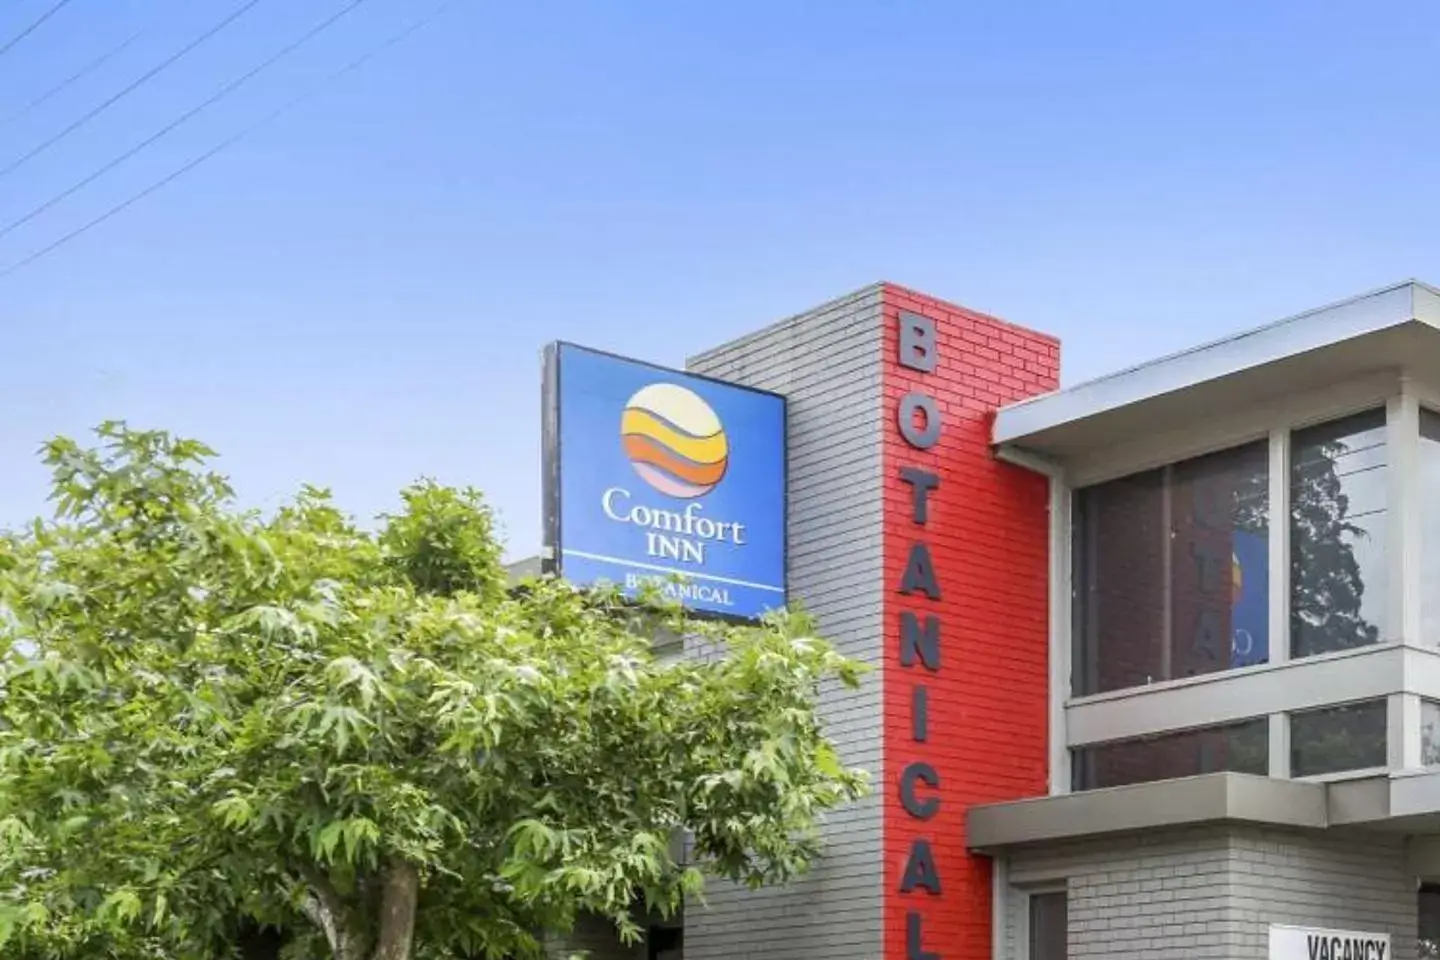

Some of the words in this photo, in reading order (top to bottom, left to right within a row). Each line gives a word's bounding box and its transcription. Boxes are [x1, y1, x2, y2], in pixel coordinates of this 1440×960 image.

[602, 487, 747, 545] Comfort
[646, 532, 705, 564] INN
[625, 572, 735, 606] BANICAL
